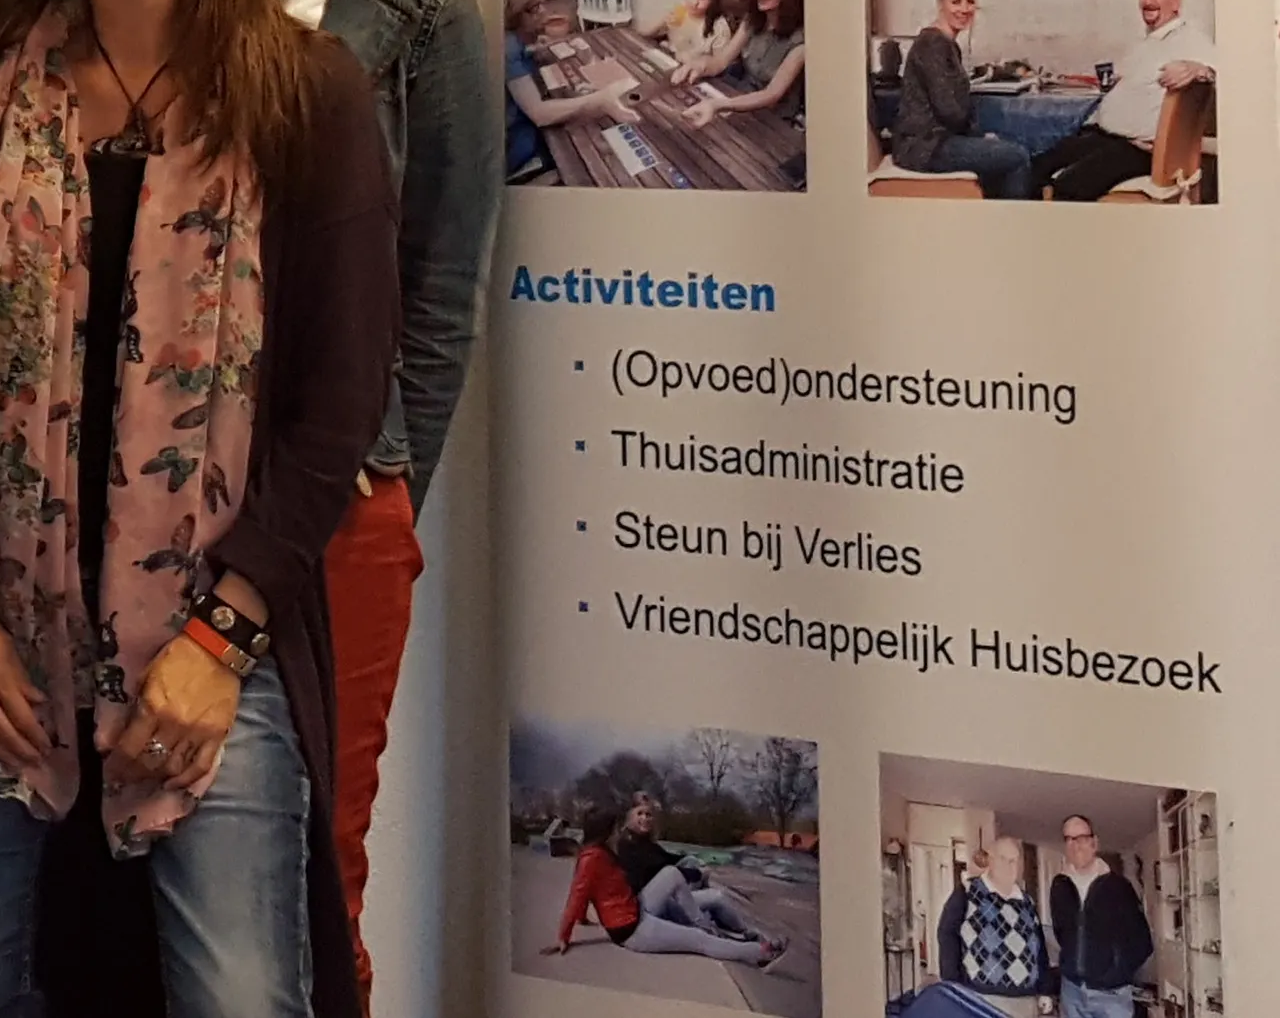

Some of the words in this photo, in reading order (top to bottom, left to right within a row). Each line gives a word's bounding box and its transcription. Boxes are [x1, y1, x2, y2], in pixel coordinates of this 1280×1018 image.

[510, 265, 776, 313] Activiteiten
[611, 348, 1077, 425] (Opvoed)ondersteuning
[611, 429, 965, 494] Thuisadministratie
[614, 510, 727, 557] Steun
[743, 519, 784, 570] bij
[795, 525, 922, 576] Verlies
[614, 590, 954, 673] Vriendschappelijk
[971, 629, 1222, 693] Huisbezoek
